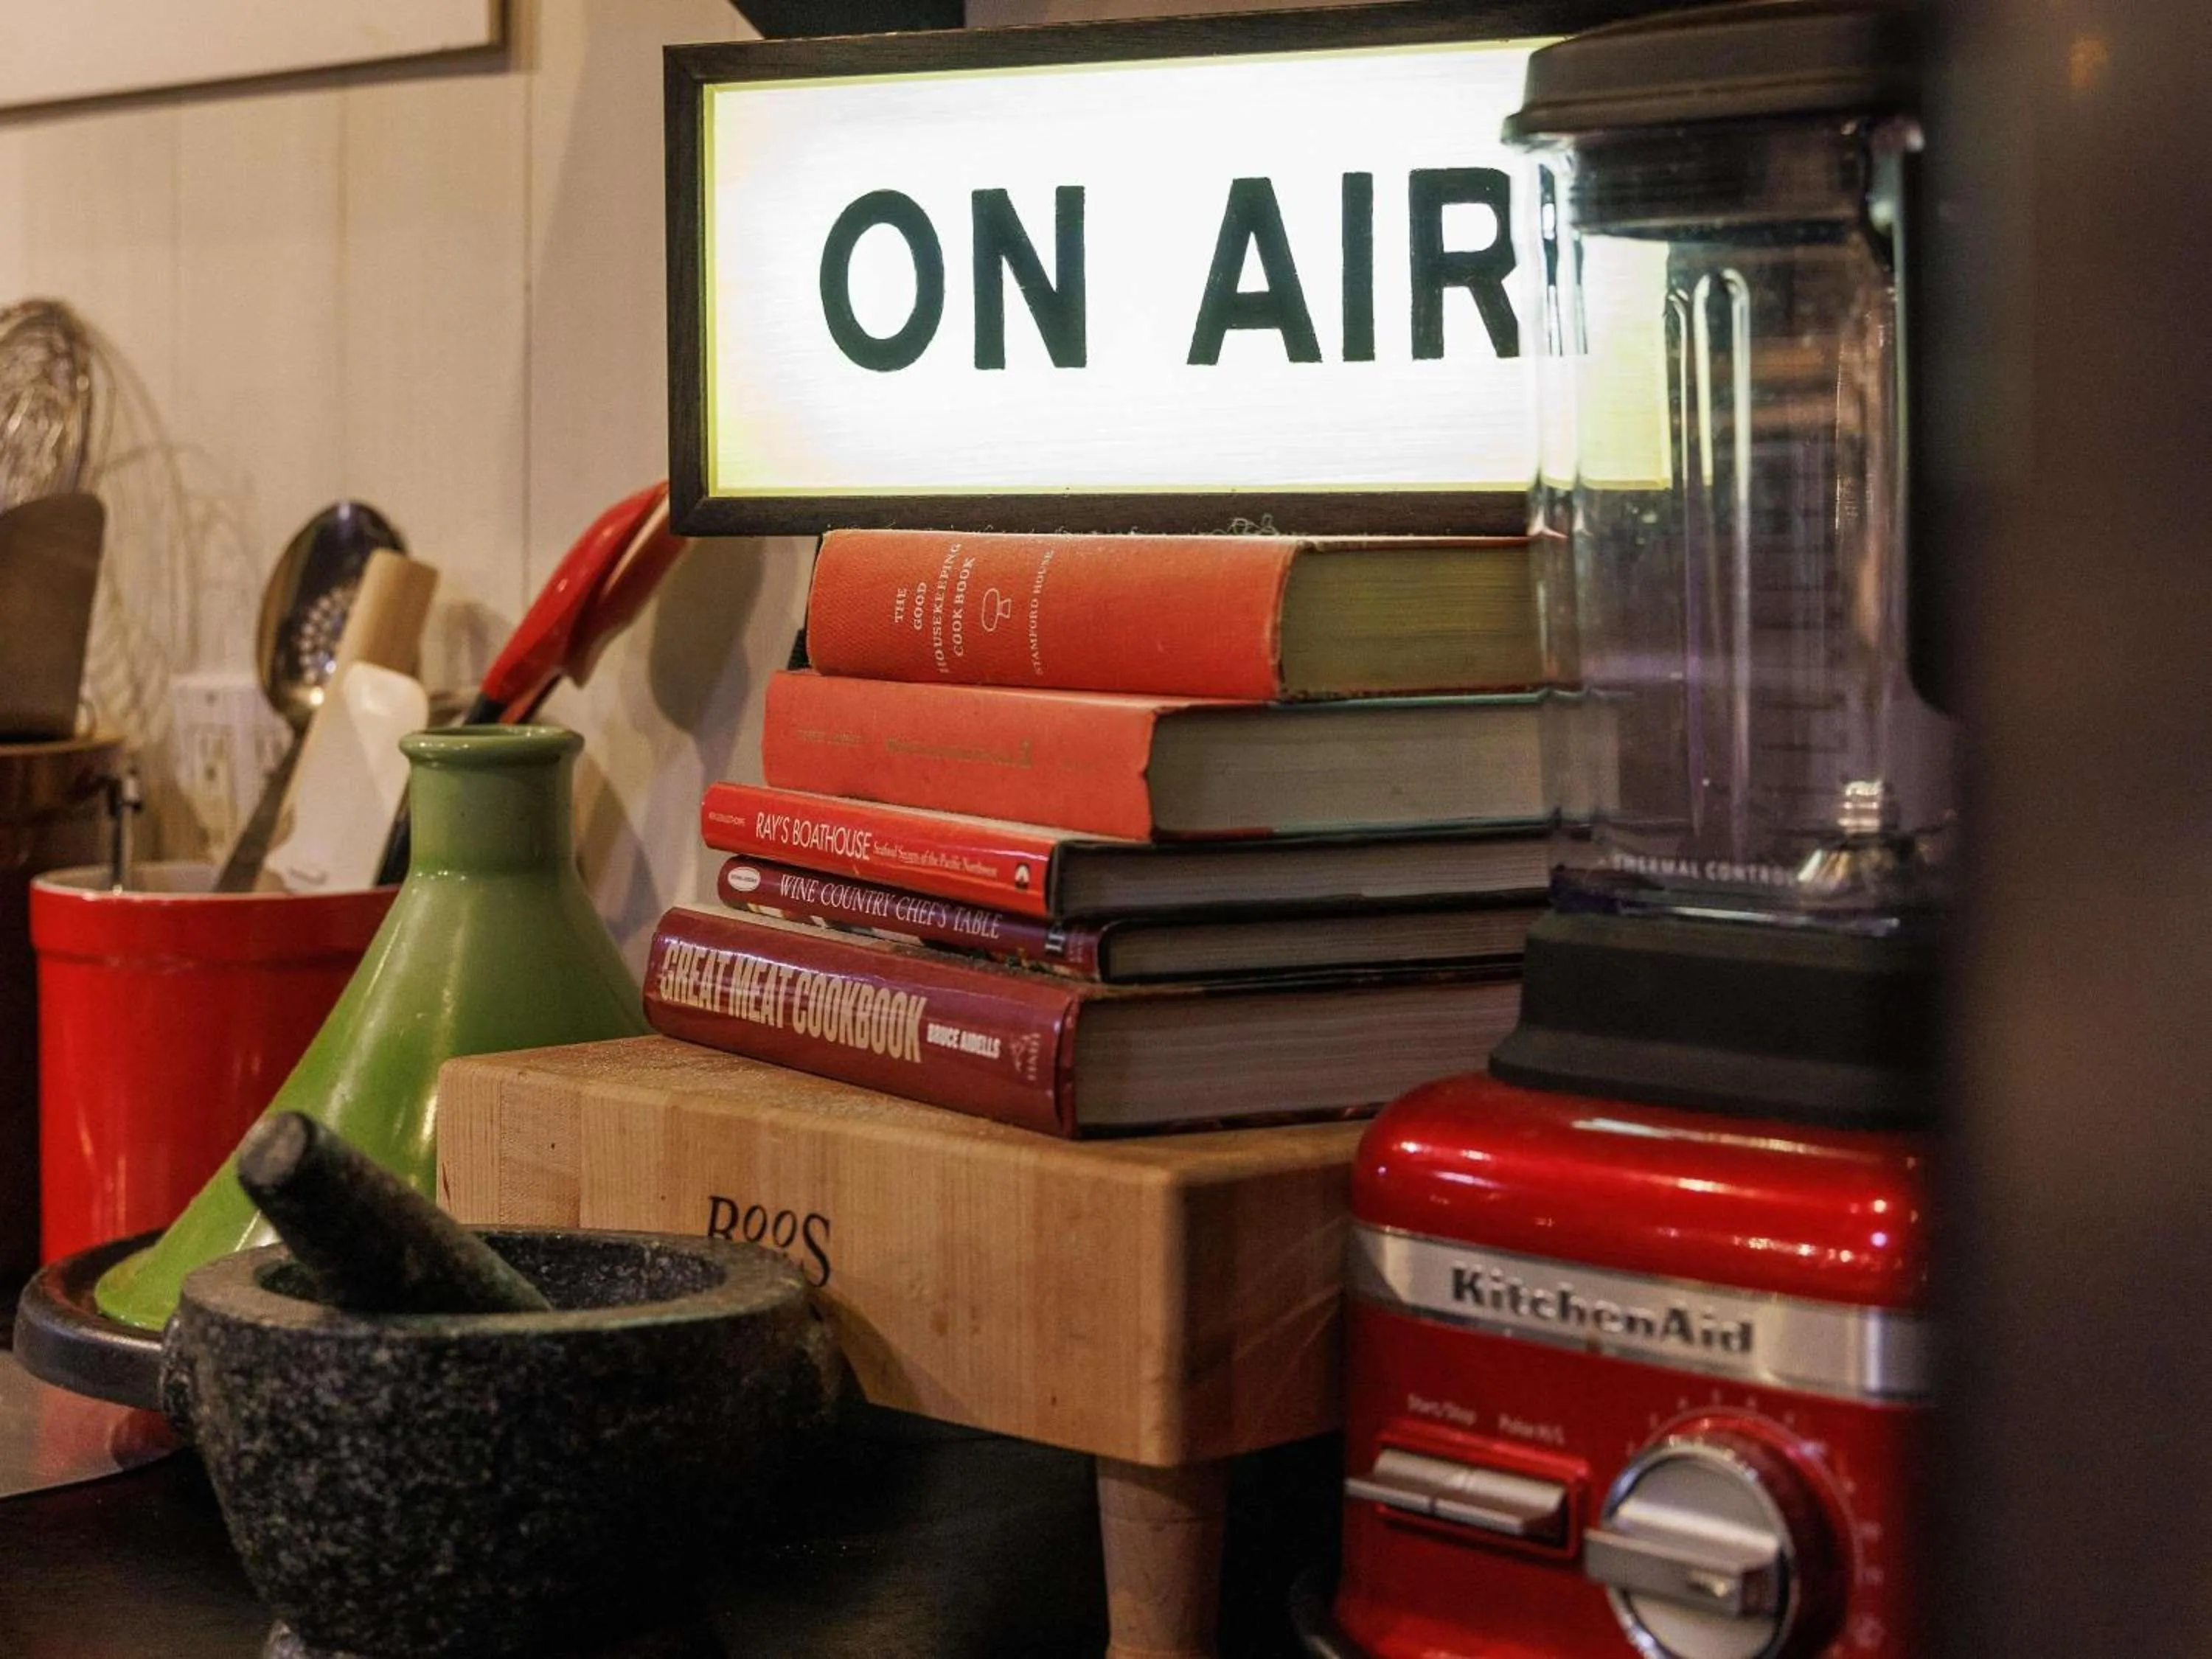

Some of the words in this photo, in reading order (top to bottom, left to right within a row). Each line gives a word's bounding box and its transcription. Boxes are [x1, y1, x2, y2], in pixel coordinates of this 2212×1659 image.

[819, 184, 1086, 373] ON
[1186, 167, 1521, 366] AIR
[894, 587, 907, 622] THE
[914, 581, 927, 630] GOOD
[933, 543, 961, 672] HOUSEKEEPING
[756, 811, 790, 844] RAY'S
[793, 818, 873, 860] BOATHOUSE
[779, 874, 820, 902] WINE
[820, 883, 895, 917] COUNTRY
[896, 895, 947, 929] CHEF'S
[951, 907, 1003, 939] TABLE
[659, 942, 730, 1013] GREAT
[728, 953, 795, 1029] MEAT
[792, 970, 928, 1063] COOKBOOK
[1450, 1264, 1756, 1354] KitchenAid
